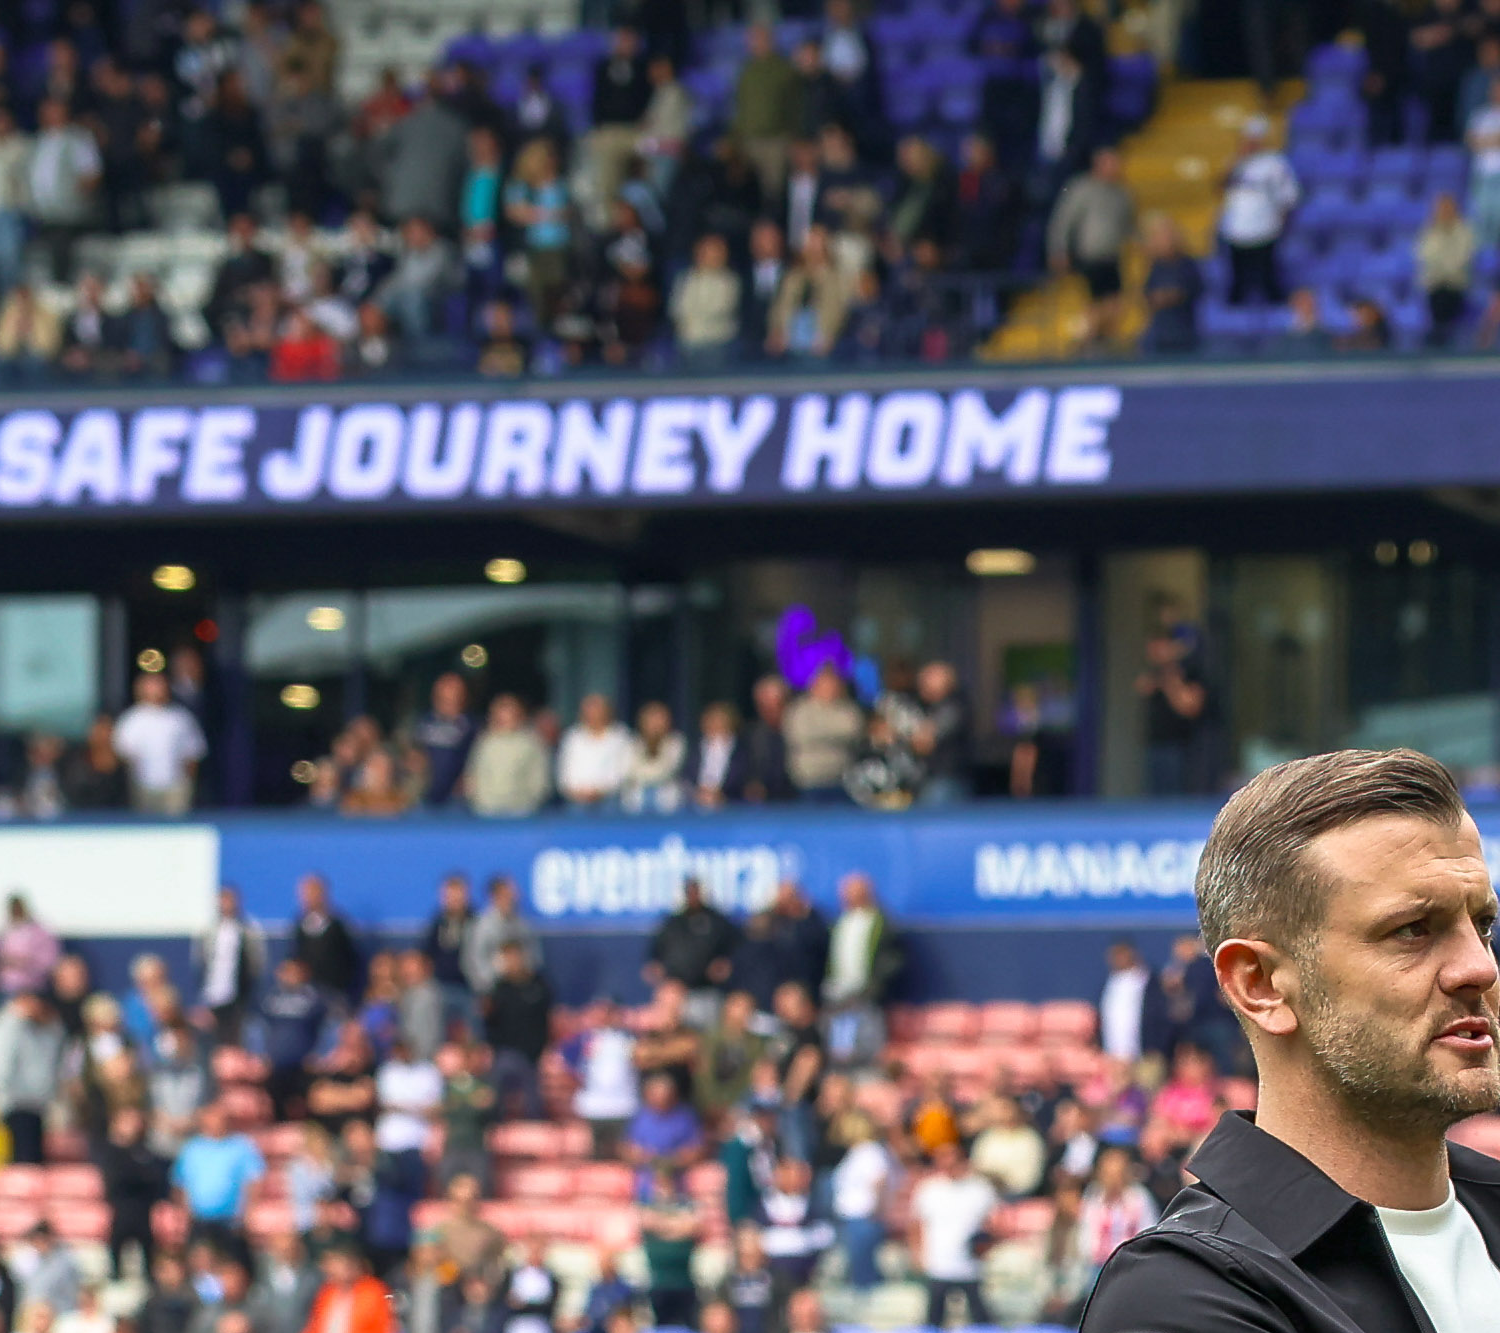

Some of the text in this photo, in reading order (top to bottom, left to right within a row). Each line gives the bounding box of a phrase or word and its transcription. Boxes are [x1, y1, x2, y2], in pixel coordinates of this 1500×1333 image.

[260, 397, 778, 500] JOURNEY
[783, 387, 1122, 490] HOME
[532, 833, 781, 915] eventura
[975, 839, 1204, 898] MANAG
